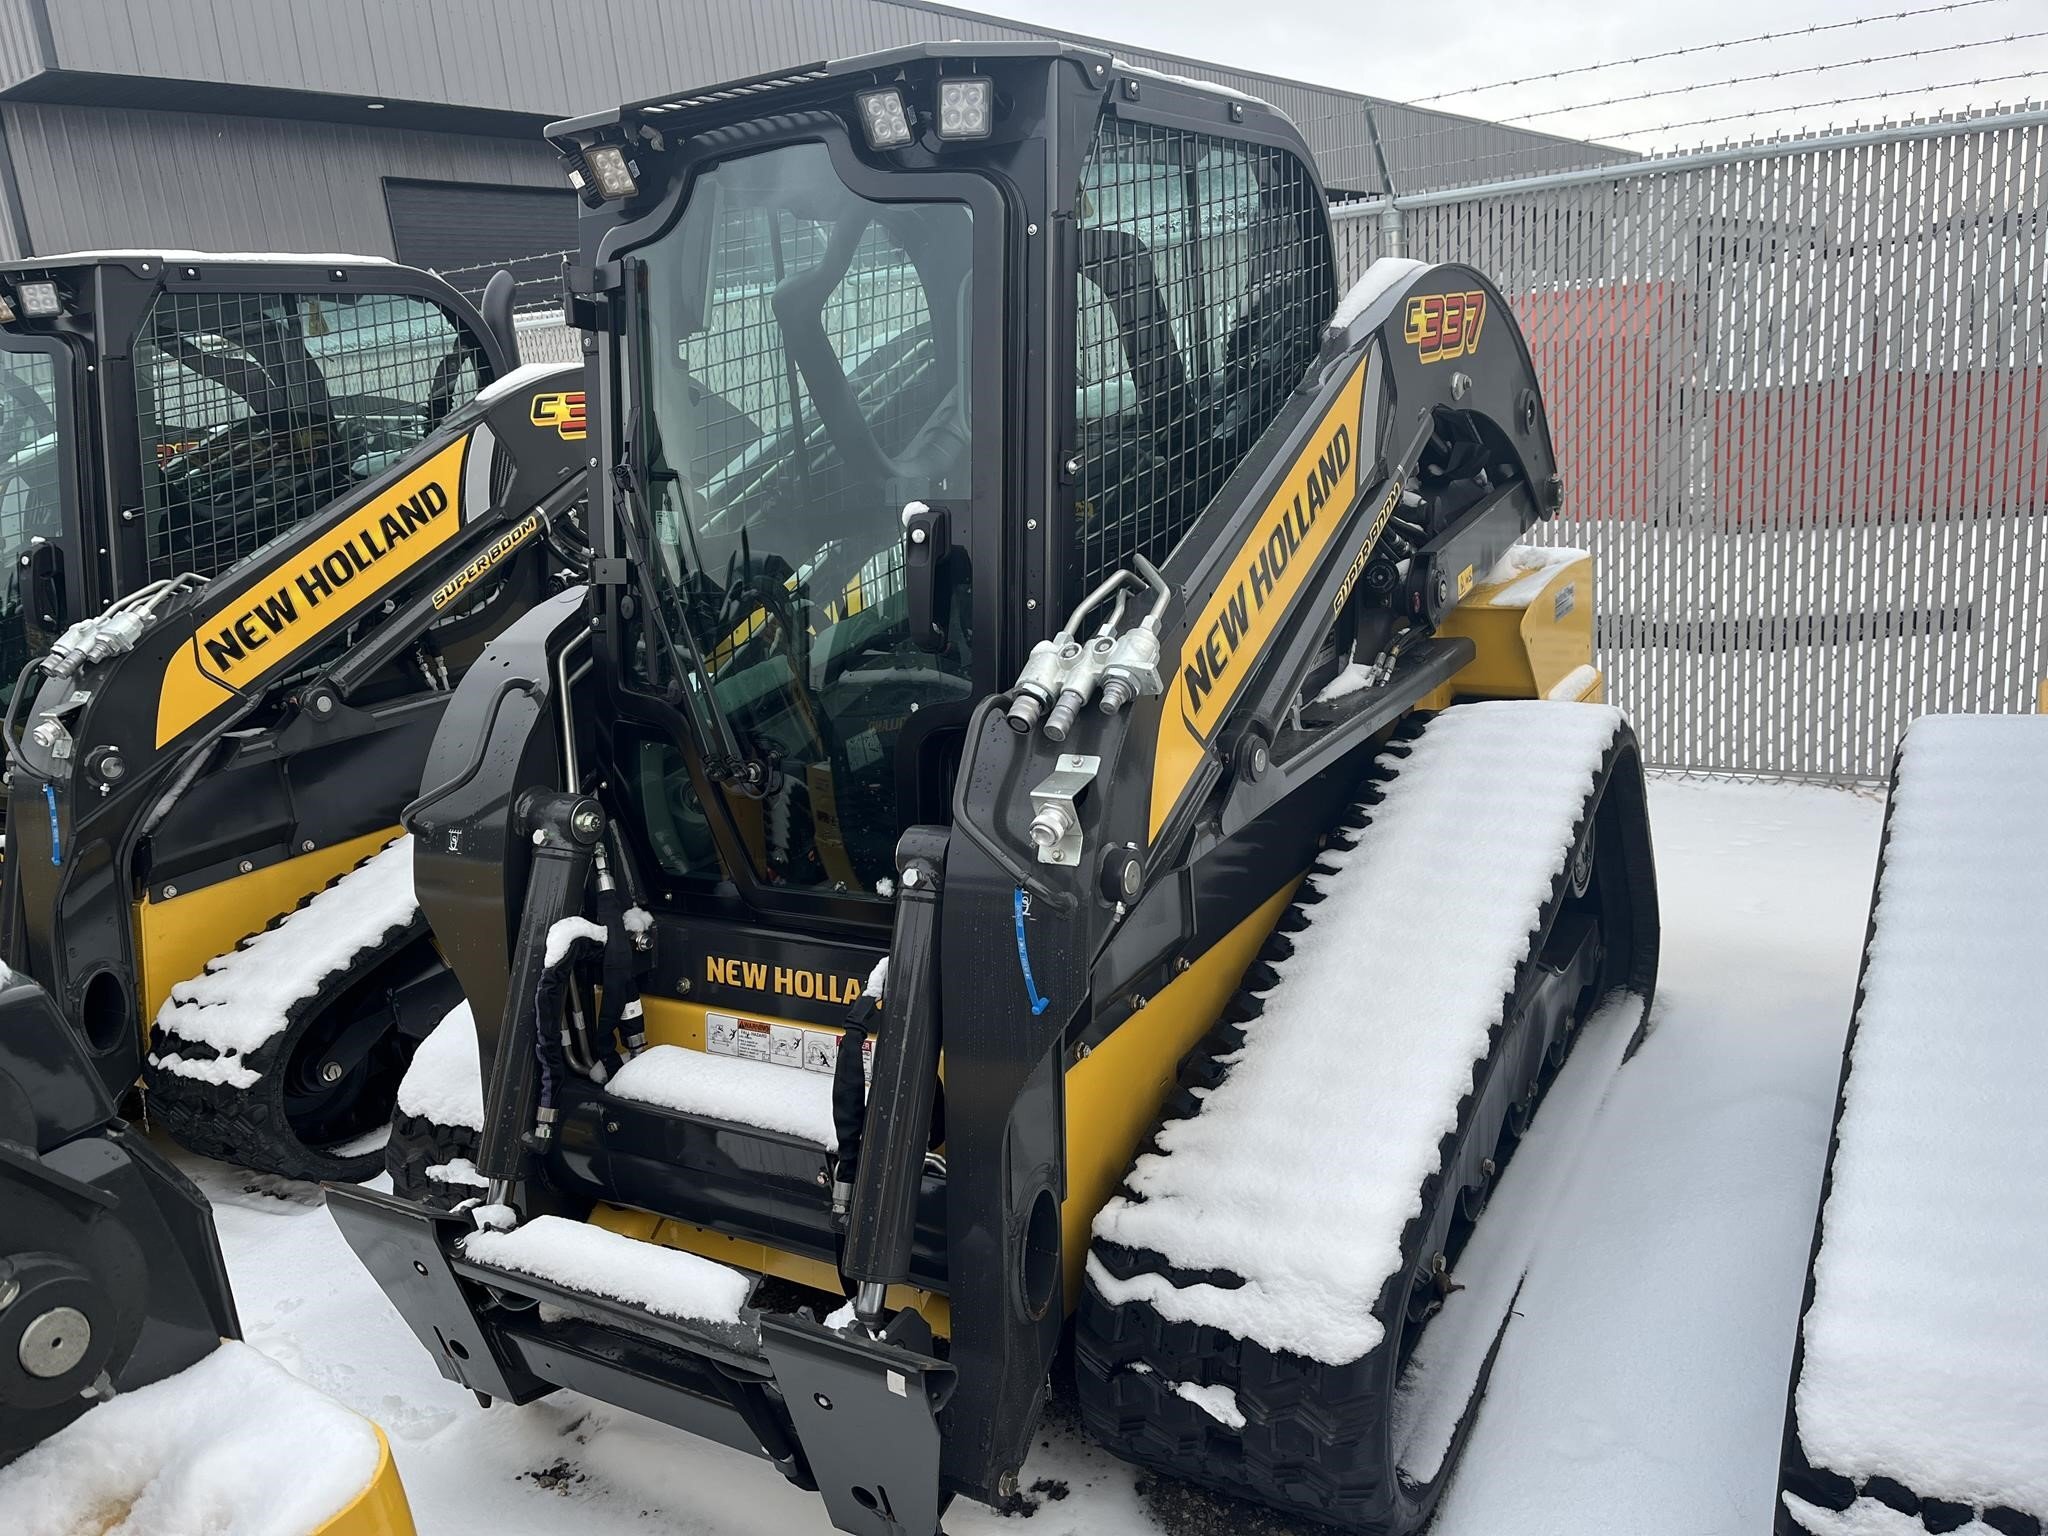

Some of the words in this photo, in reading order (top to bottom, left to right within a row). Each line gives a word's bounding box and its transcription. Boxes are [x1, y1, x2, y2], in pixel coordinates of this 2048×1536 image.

[1404, 290, 1487, 365] C337
[204, 586, 299, 673] NEW
[295, 482, 448, 608] HOLLAND
[432, 556, 490, 610] SUPER
[488, 516, 537, 565] BOOM
[1184, 580, 1249, 715] NEW
[1249, 423, 1351, 612] HOLLAND
[706, 955, 768, 991] NEW
[774, 966, 866, 1006] HOLLA
